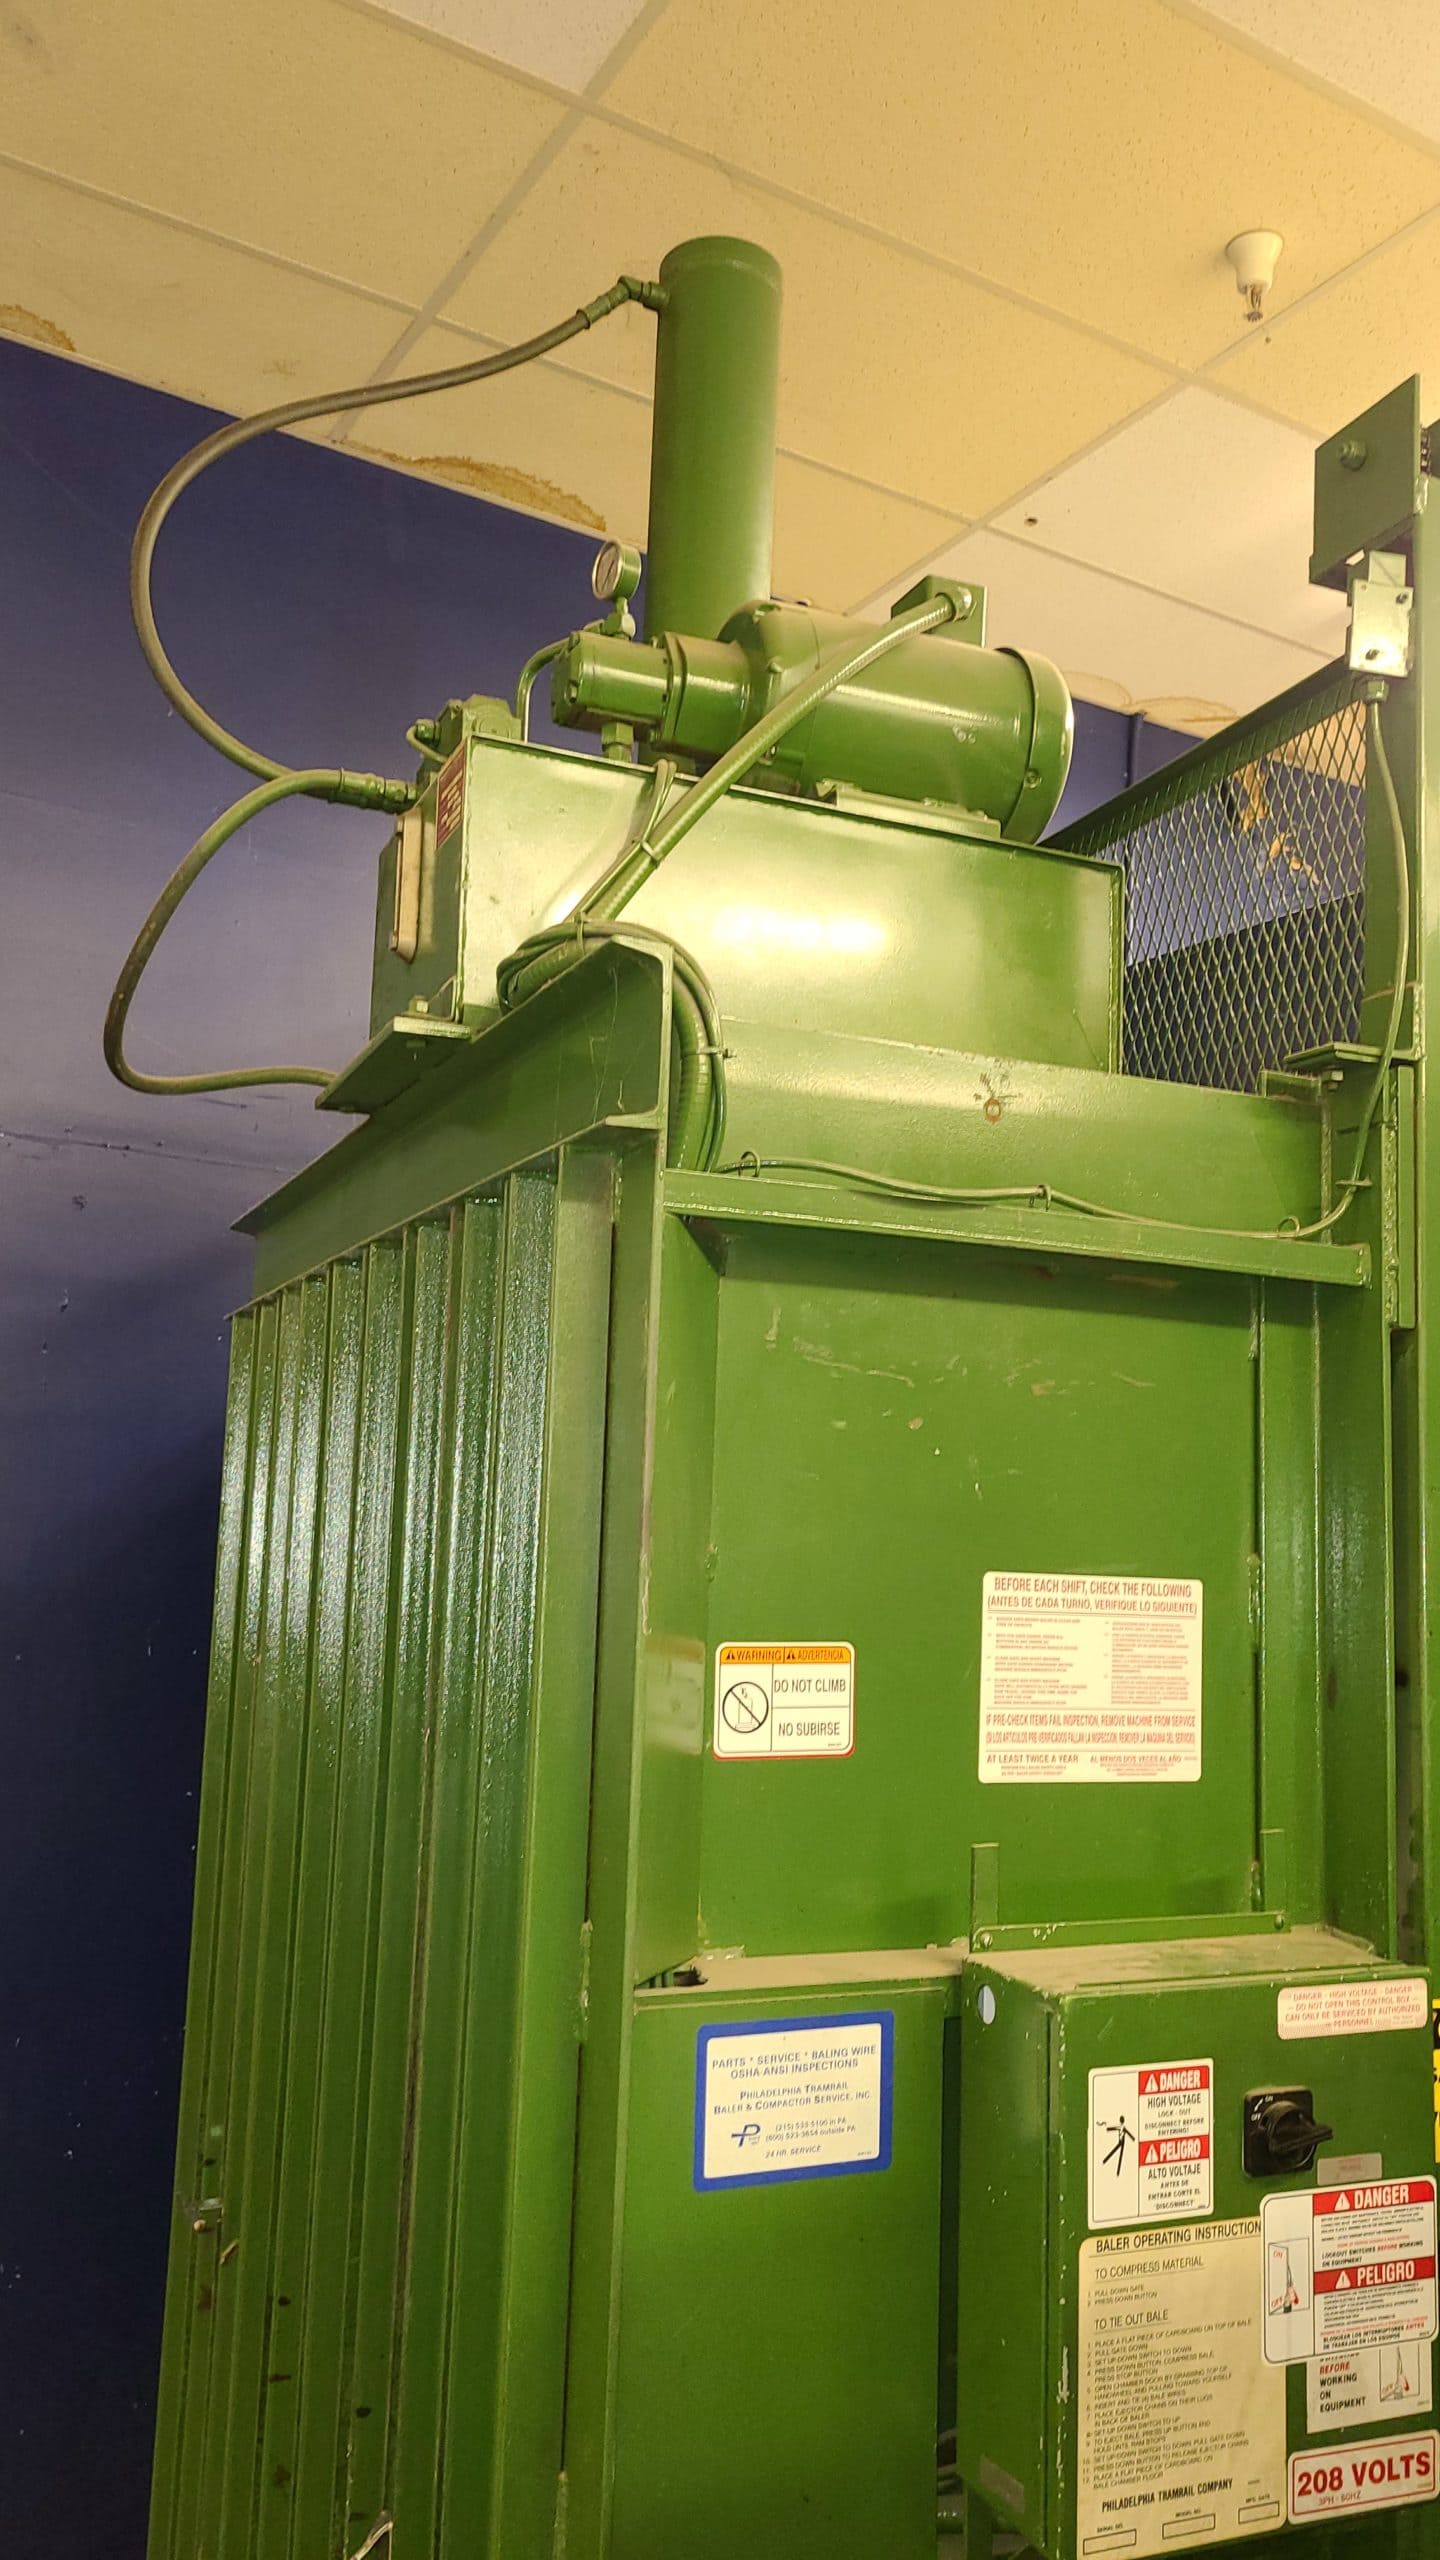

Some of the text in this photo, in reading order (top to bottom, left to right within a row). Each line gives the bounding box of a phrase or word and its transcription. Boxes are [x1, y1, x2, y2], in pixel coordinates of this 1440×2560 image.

[994, 1578, 1192, 1597] BEFORE EACH SHIFT, CHECK THE FOLLOWING
[988, 1596, 1019, 1609] (ANTES
[1021, 1597, 1032, 1610] DE
[1035, 1597, 1059, 1610] CADA
[1062, 1598, 1091, 1612] TURNO,
[1095, 1599, 1137, 1613] VERIFIQUE
[1139, 1600, 1150, 1613] LO
[736, 1650, 782, 1661] WARNING
[797, 1650, 844, 1660] ADVERTENCIA
[774, 1679, 846, 1692] DO NOT CLIMB
[986, 1714, 991, 1726] IF
[993, 1714, 1028, 1726] PRE-CHECK
[1029, 1715, 1048, 1727] ITEMS
[1049, 1715, 1061, 1727] FAIL
[1101, 1715, 1125, 1727] REMOVE
[1127, 1715, 1152, 1727] MACHINE
[1154, 1715, 1170, 1727] FROM
[1172, 1716, 1195, 1727] SERVICE
[778, 1722, 840, 1736] NO SUBIRSE
[987, 1755, 1079, 1763] AT LEAST TWICE A YEAR
[1293, 1986, 1413, 2001] DANGER HIGH VOLTAGE DANGER
[1325, 2000, 1344, 2008] OPEN
[1346, 1999, 1360, 2007] THIS
[1362, 1997, 1393, 2005] CONTROL
[1285, 2014, 1300, 2022] CAN
[1302, 2012, 1319, 2020] ONLY
[1333, 2009, 1366, 2018] SERVICED
[1367, 2008, 1376, 2016] BY
[1378, 2005, 1420, 2015] AUTHORIZED
[1334, 2019, 1373, 2027] PERSONNEL
[712, 2046, 876, 2069] PARTS SERVICE BALING WIRE
[791, 2058, 858, 2074] INSPECTIONS
[1160, 2070, 1200, 2090] DANGER
[739, 2082, 848, 2100] PHILADELPHIA TRAMRAIL
[713, 2103, 743, 2115] BALER
[755, 2097, 811, 2111] COMPACTOR
[1148, 2093, 1201, 2109] HIGH VOLTAGE
[1145, 2118, 1204, 2129] DISCONNECT BEFORE
[790, 2145, 821, 2156] SERVICE
[1160, 2139, 1201, 2161] PELIGRO
[1148, 2164, 1200, 2179] ALTO VOLTAJE
[1354, 2184, 1409, 2209] DANGER
[1096, 2237, 1129, 2253] BALER
[1133, 2229, 1191, 2248] OPERATING
[1322, 2250, 1347, 2260] LOCKOUT
[1349, 2247, 1375, 2256] SWITCHES
[1377, 2244, 1397, 2252] BEFORE
[1399, 2241, 1423, 2250] WORKING
[1095, 2256, 1203, 2280] TO COMPRESS MATERIAL
[1331, 2257, 1362, 2266] EQUIPMENT
[1357, 2260, 1415, 2286] PELIGRO
[1095, 2309, 1169, 2330] TO TIE OUT BALE
[1323, 2333, 1350, 2343] BLOQUEAR
[1352, 2331, 1361, 2339] LOS
[1363, 2325, 1404, 2338] INTERRUPTORES
[1406, 2323, 1424, 2332] ANTES
[1332, 2339, 1358, 2349] TRABAJAR
[1378, 2333, 1400, 2342] EQUIPOS
[1320, 2361, 1350, 2375] BEFORE
[1320, 2373, 1357, 2387] WORKING
[1320, 2390, 1331, 2400] ON
[1320, 2396, 1366, 2413] EQUIPMENT
[1298, 2452, 1430, 2496] 208 VOLTS
[1102, 2479, 1232, 2512] PHILADELPHIA TRAMRAIL COMPANY
